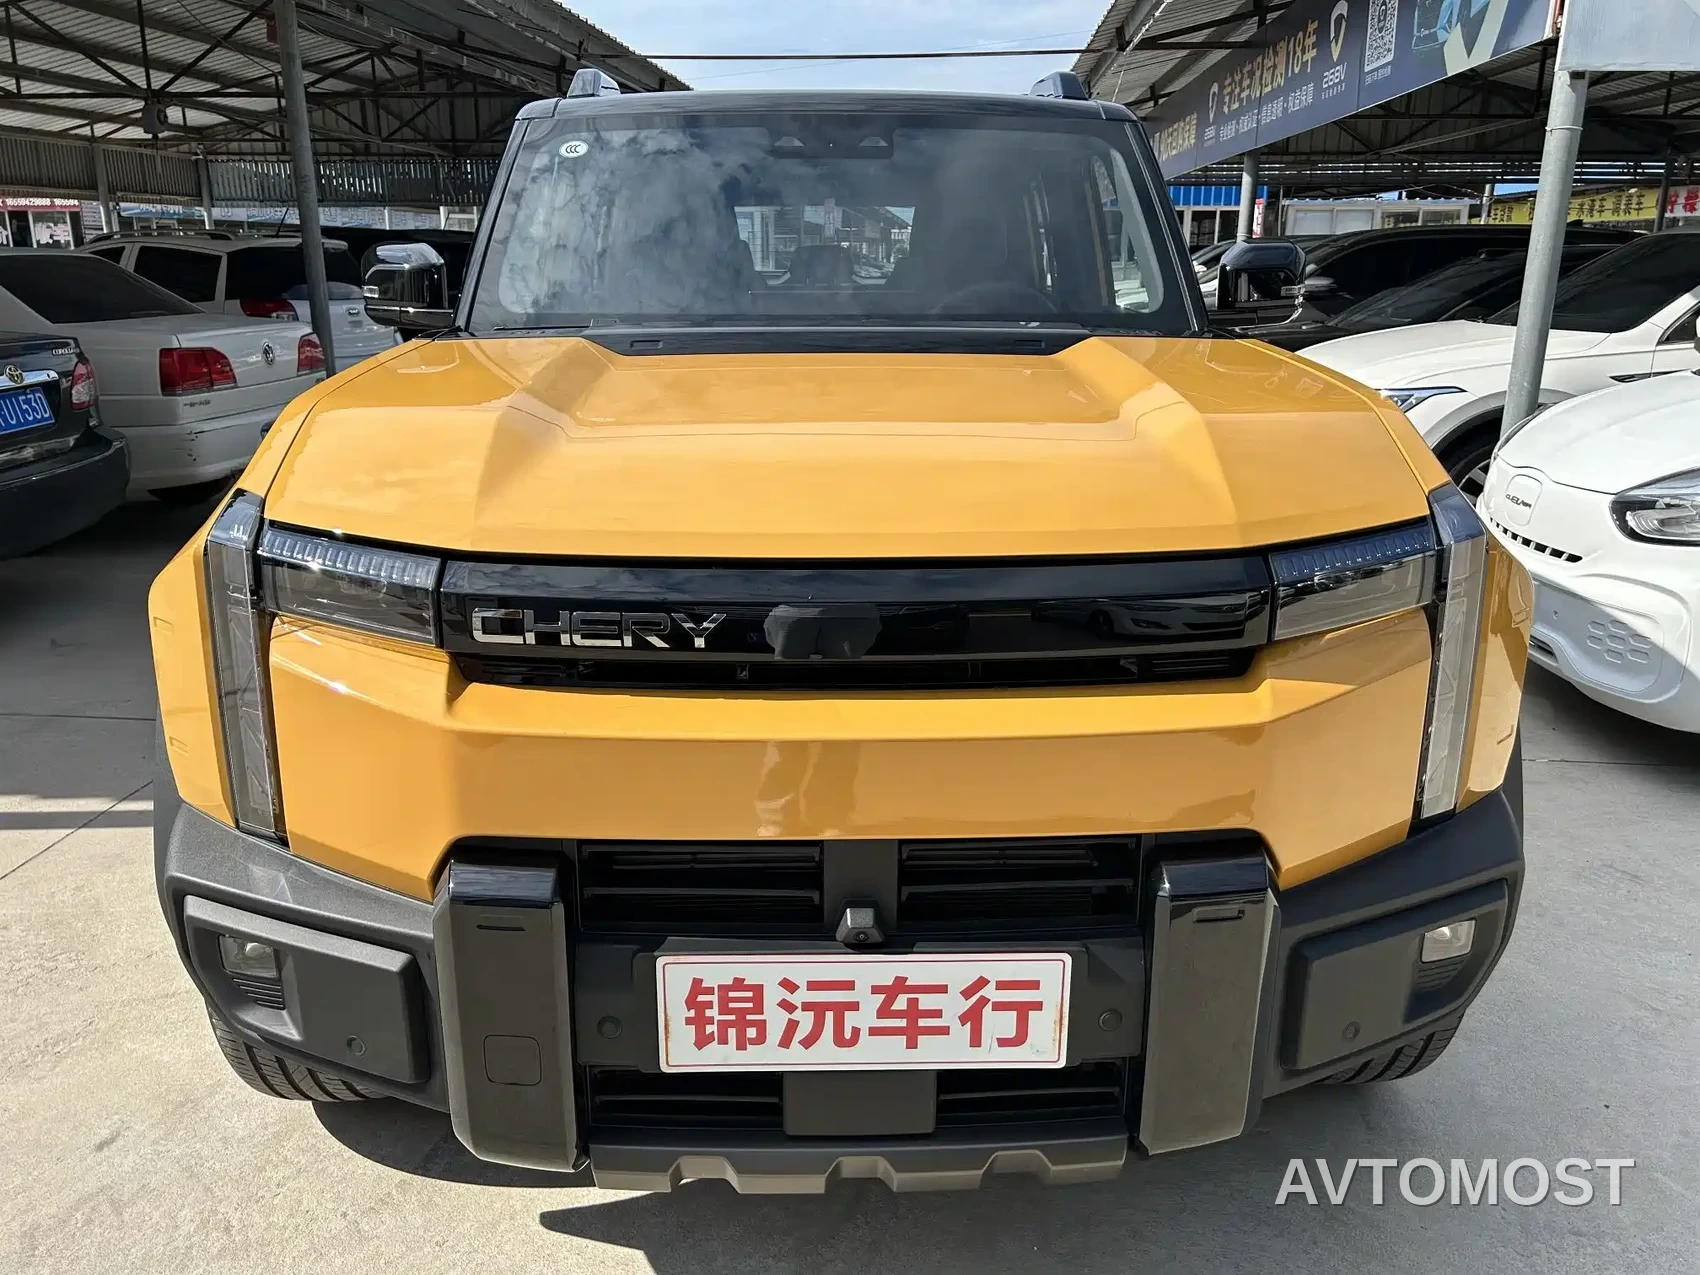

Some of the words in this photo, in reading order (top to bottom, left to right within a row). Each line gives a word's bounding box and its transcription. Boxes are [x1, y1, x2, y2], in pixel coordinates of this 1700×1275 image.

[1222, 19, 1318, 115] 专注车况检测18年
[1322, 62, 1347, 88] 268V
[472, 607, 727, 649] CHERY
[684, 975, 1044, 1051] 锦沅车行
